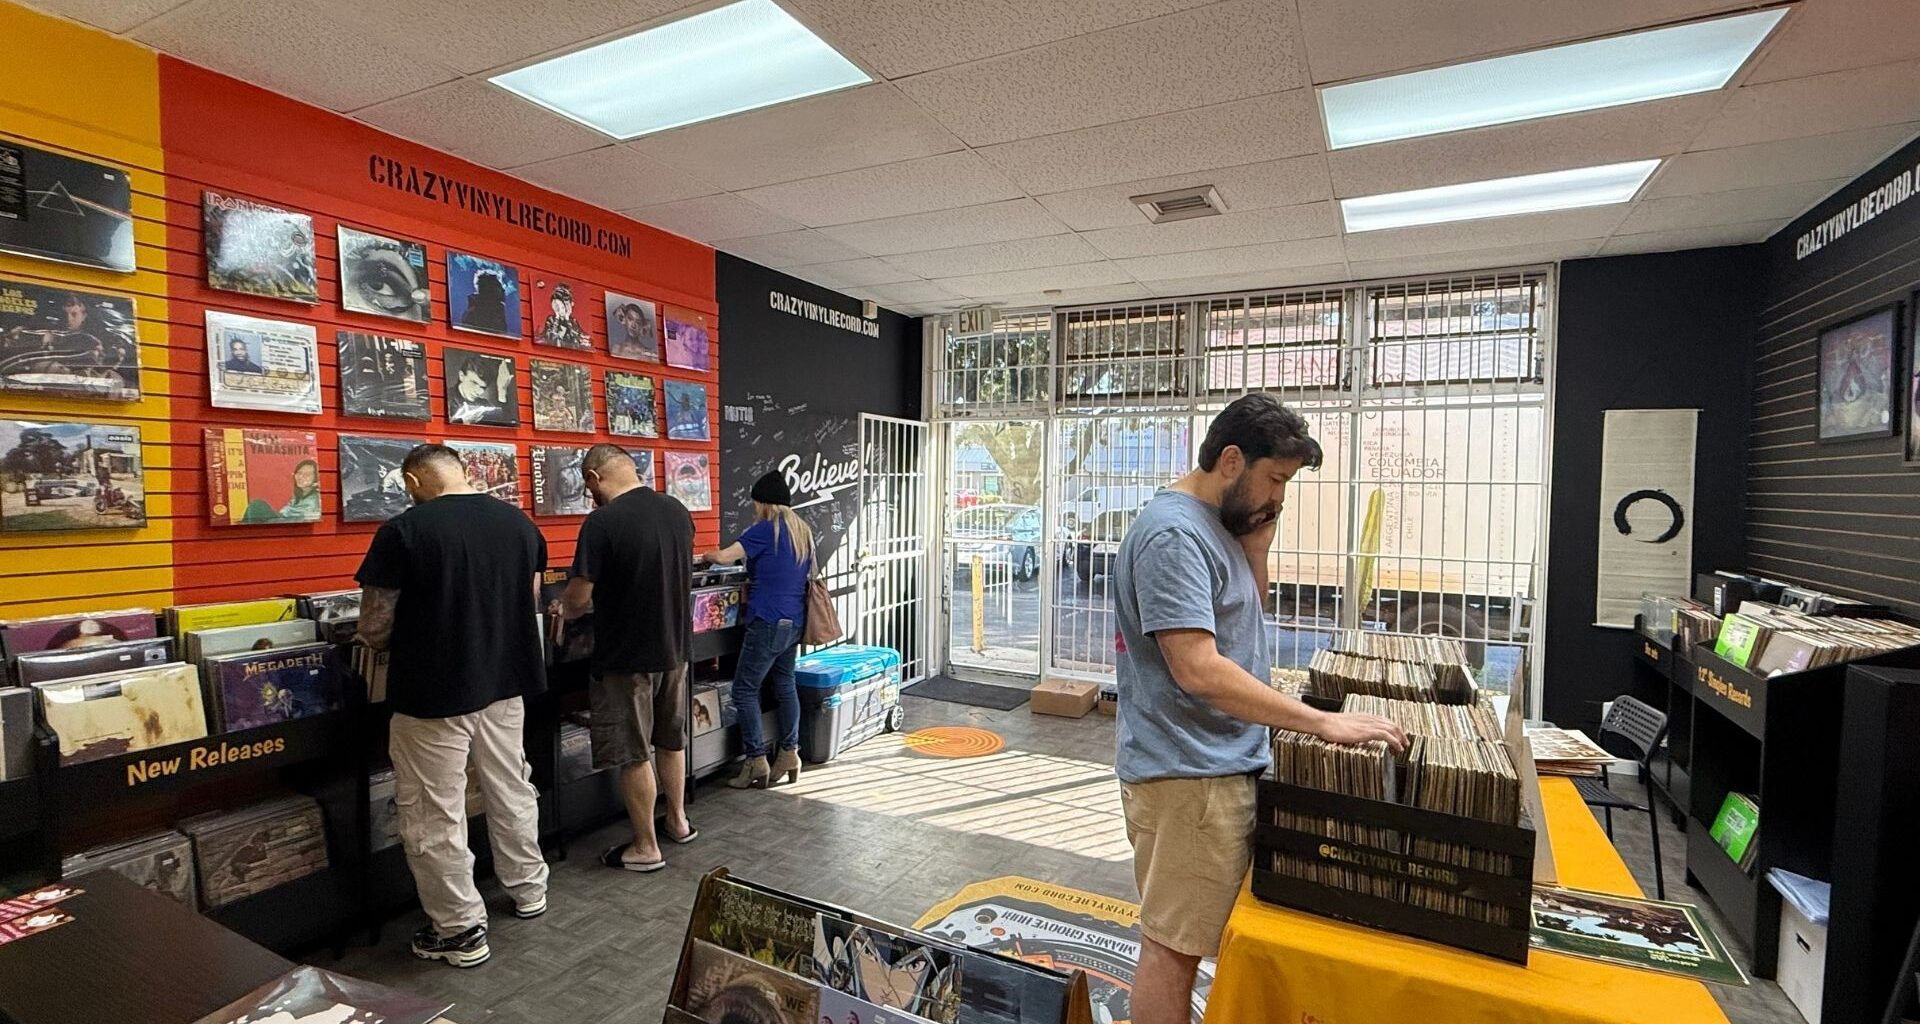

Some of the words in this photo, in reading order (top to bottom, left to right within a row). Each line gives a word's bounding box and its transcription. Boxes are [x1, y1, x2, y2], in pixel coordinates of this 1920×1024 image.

[369, 154, 632, 259] CRAZYVINYLRECORD.COM
[769, 290, 880, 339] CRAZYVINYLRECORD.COM
[958, 308, 986, 333] EXIT
[250, 444, 310, 457] YAMASHITA
[1368, 458, 1440, 468] COLOMBIA
[778, 442, 873, 497] Believe!
[243, 653, 326, 681] MEGADETH
[127, 757, 181, 786] New
[190, 734, 286, 771] Releases
[1032, 919, 1084, 941] GROOVE
[785, 994, 805, 1014] WE
